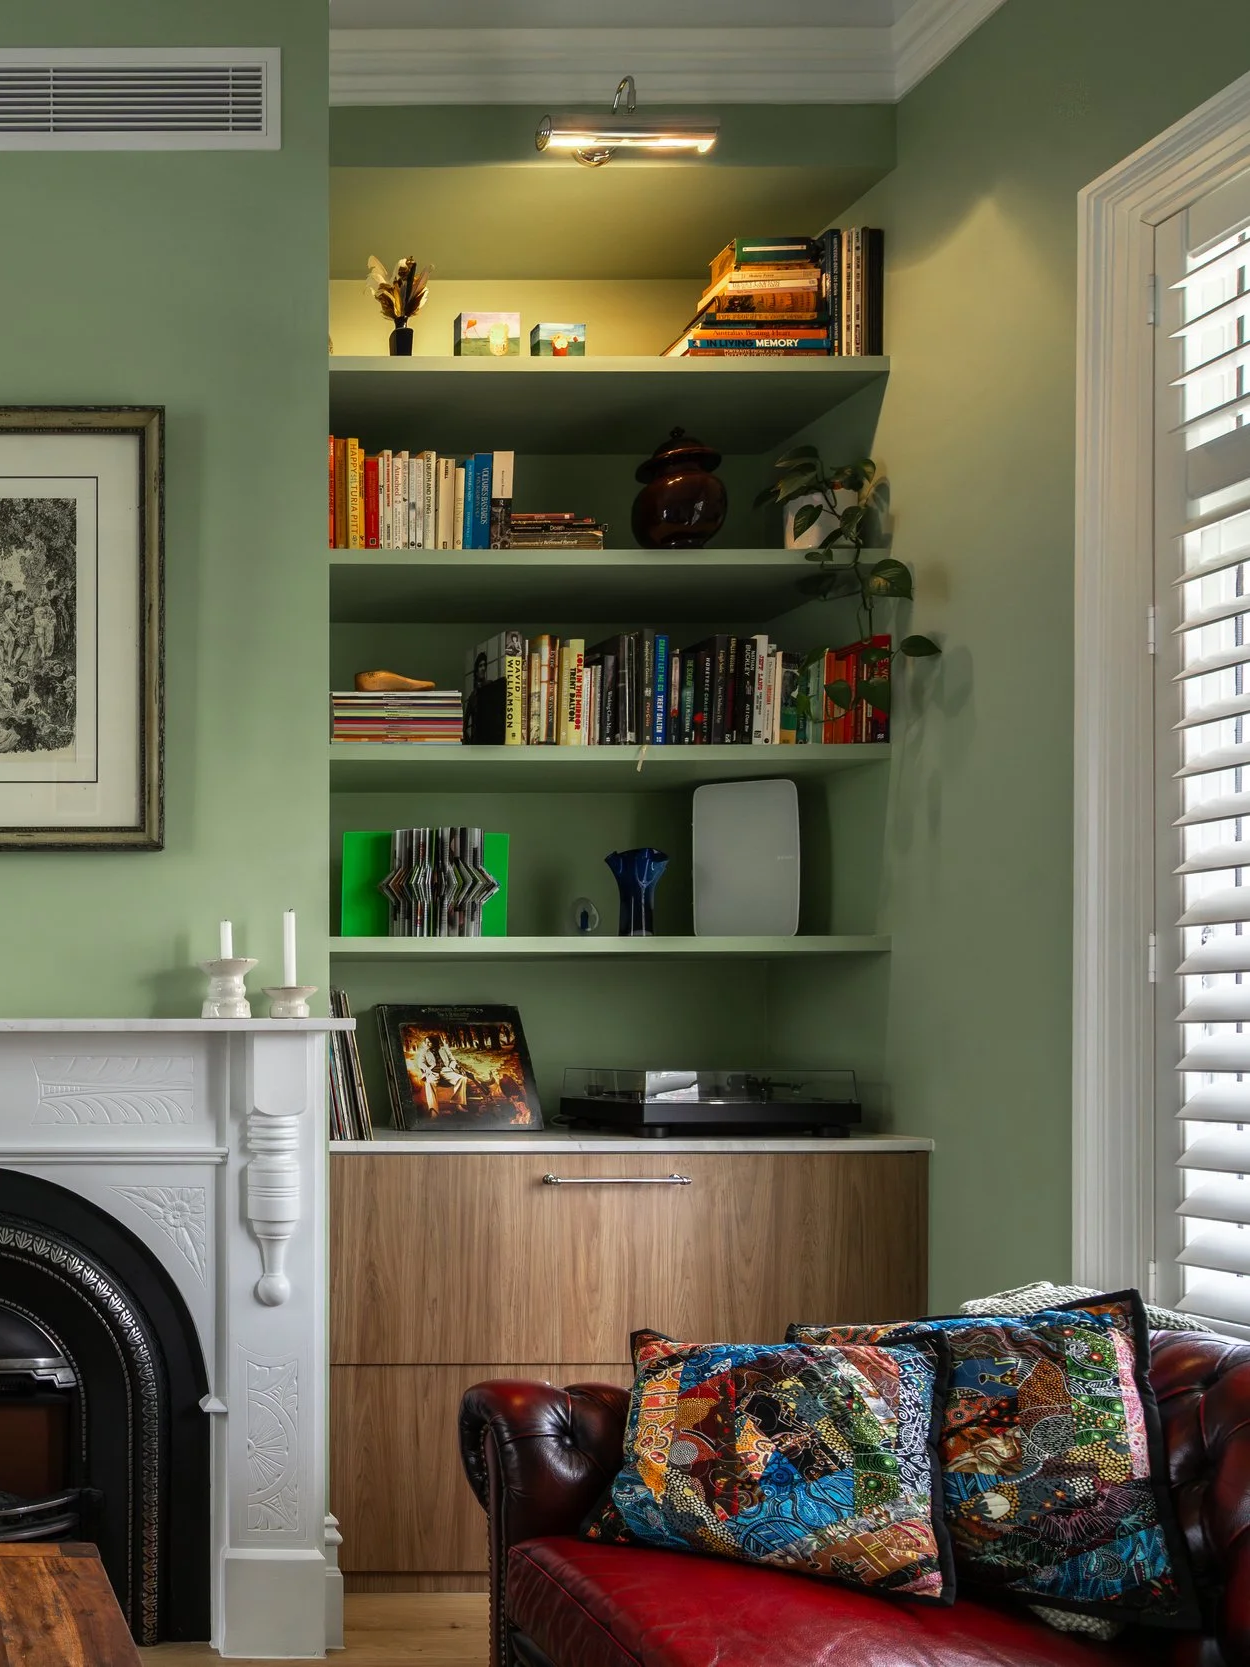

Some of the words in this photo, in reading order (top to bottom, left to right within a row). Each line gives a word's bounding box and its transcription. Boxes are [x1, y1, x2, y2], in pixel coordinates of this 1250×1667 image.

[756, 339, 799, 347] MEMORY
[350, 444, 358, 473] HAPPY
[426, 454, 431, 462] ON
[576, 675, 583, 683] IN
[657, 674, 664, 682] ME
[506, 660, 514, 728] WILLIAMSON
[568, 692, 576, 723] DALTON
[574, 699, 582, 730] MIRROR
